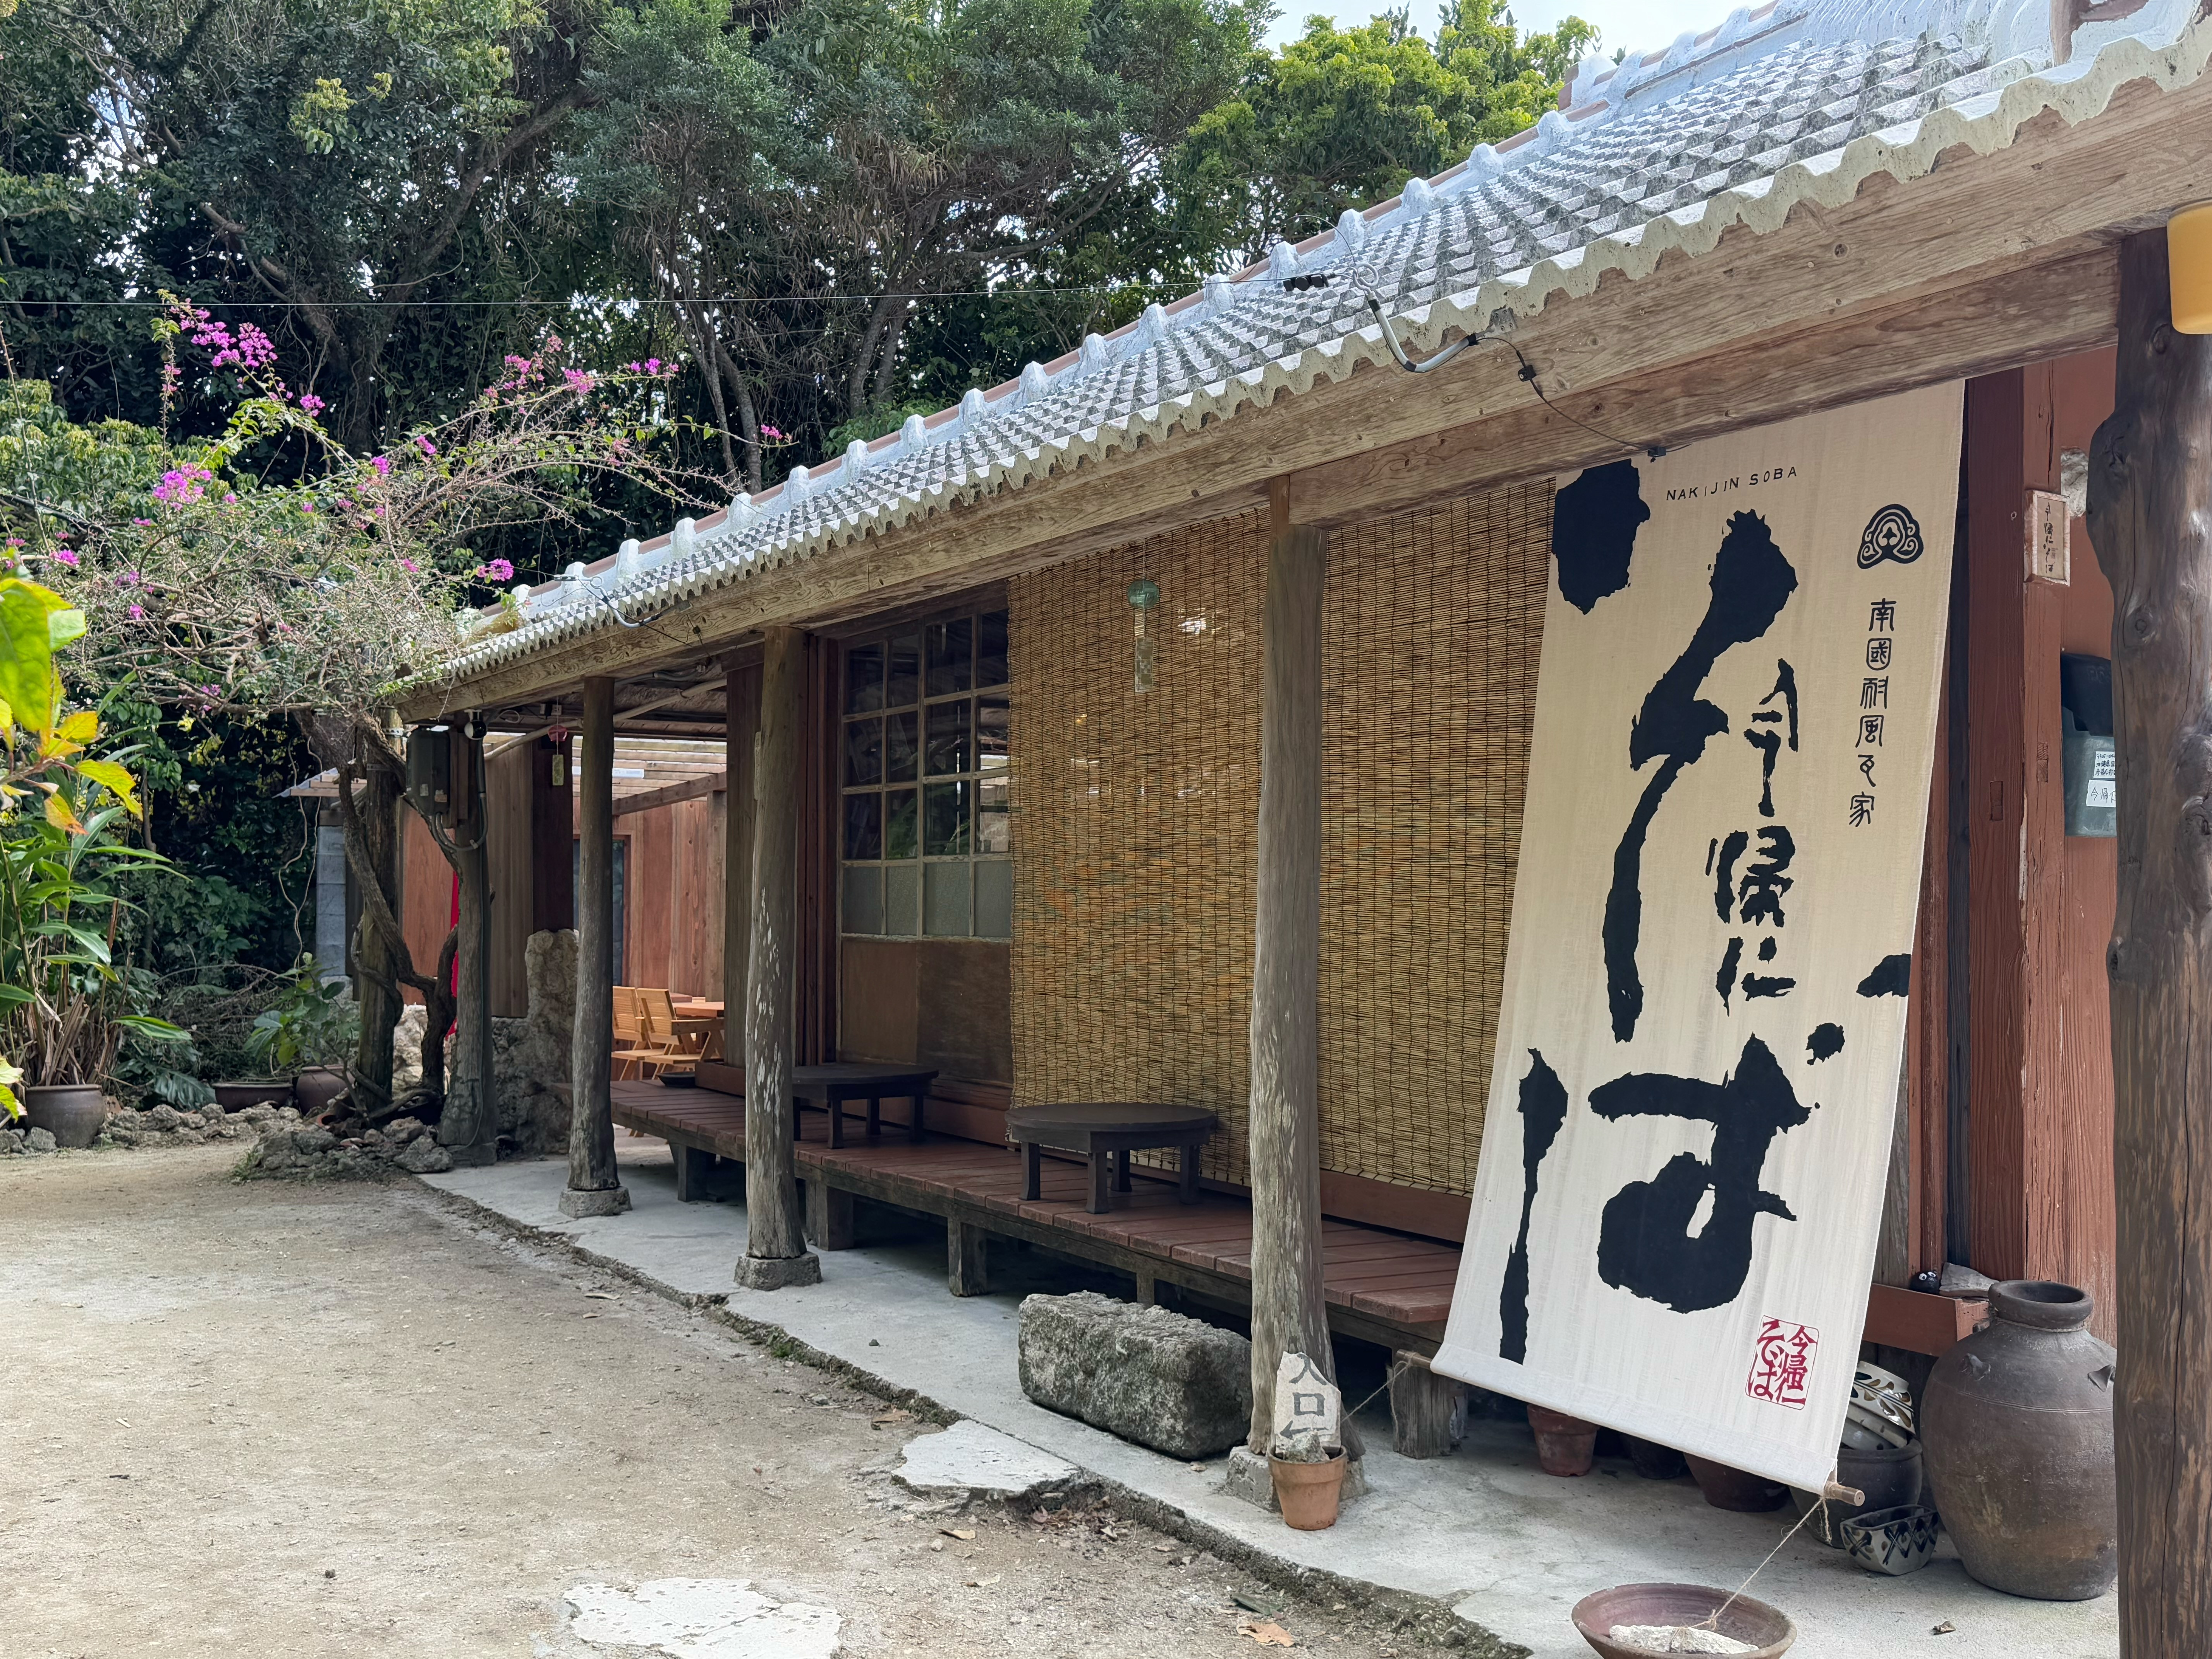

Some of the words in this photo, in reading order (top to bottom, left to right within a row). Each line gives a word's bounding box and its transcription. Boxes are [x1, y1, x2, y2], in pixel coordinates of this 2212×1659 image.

[1666, 477, 1740, 500] NAKIJIN
[1749, 466, 1797, 486] SOBA
[1499, 459, 1911, 1365] そば
[1289, 1353, 1327, 1416] 入口
[1774, 1325, 1817, 1404] 今帰仁
